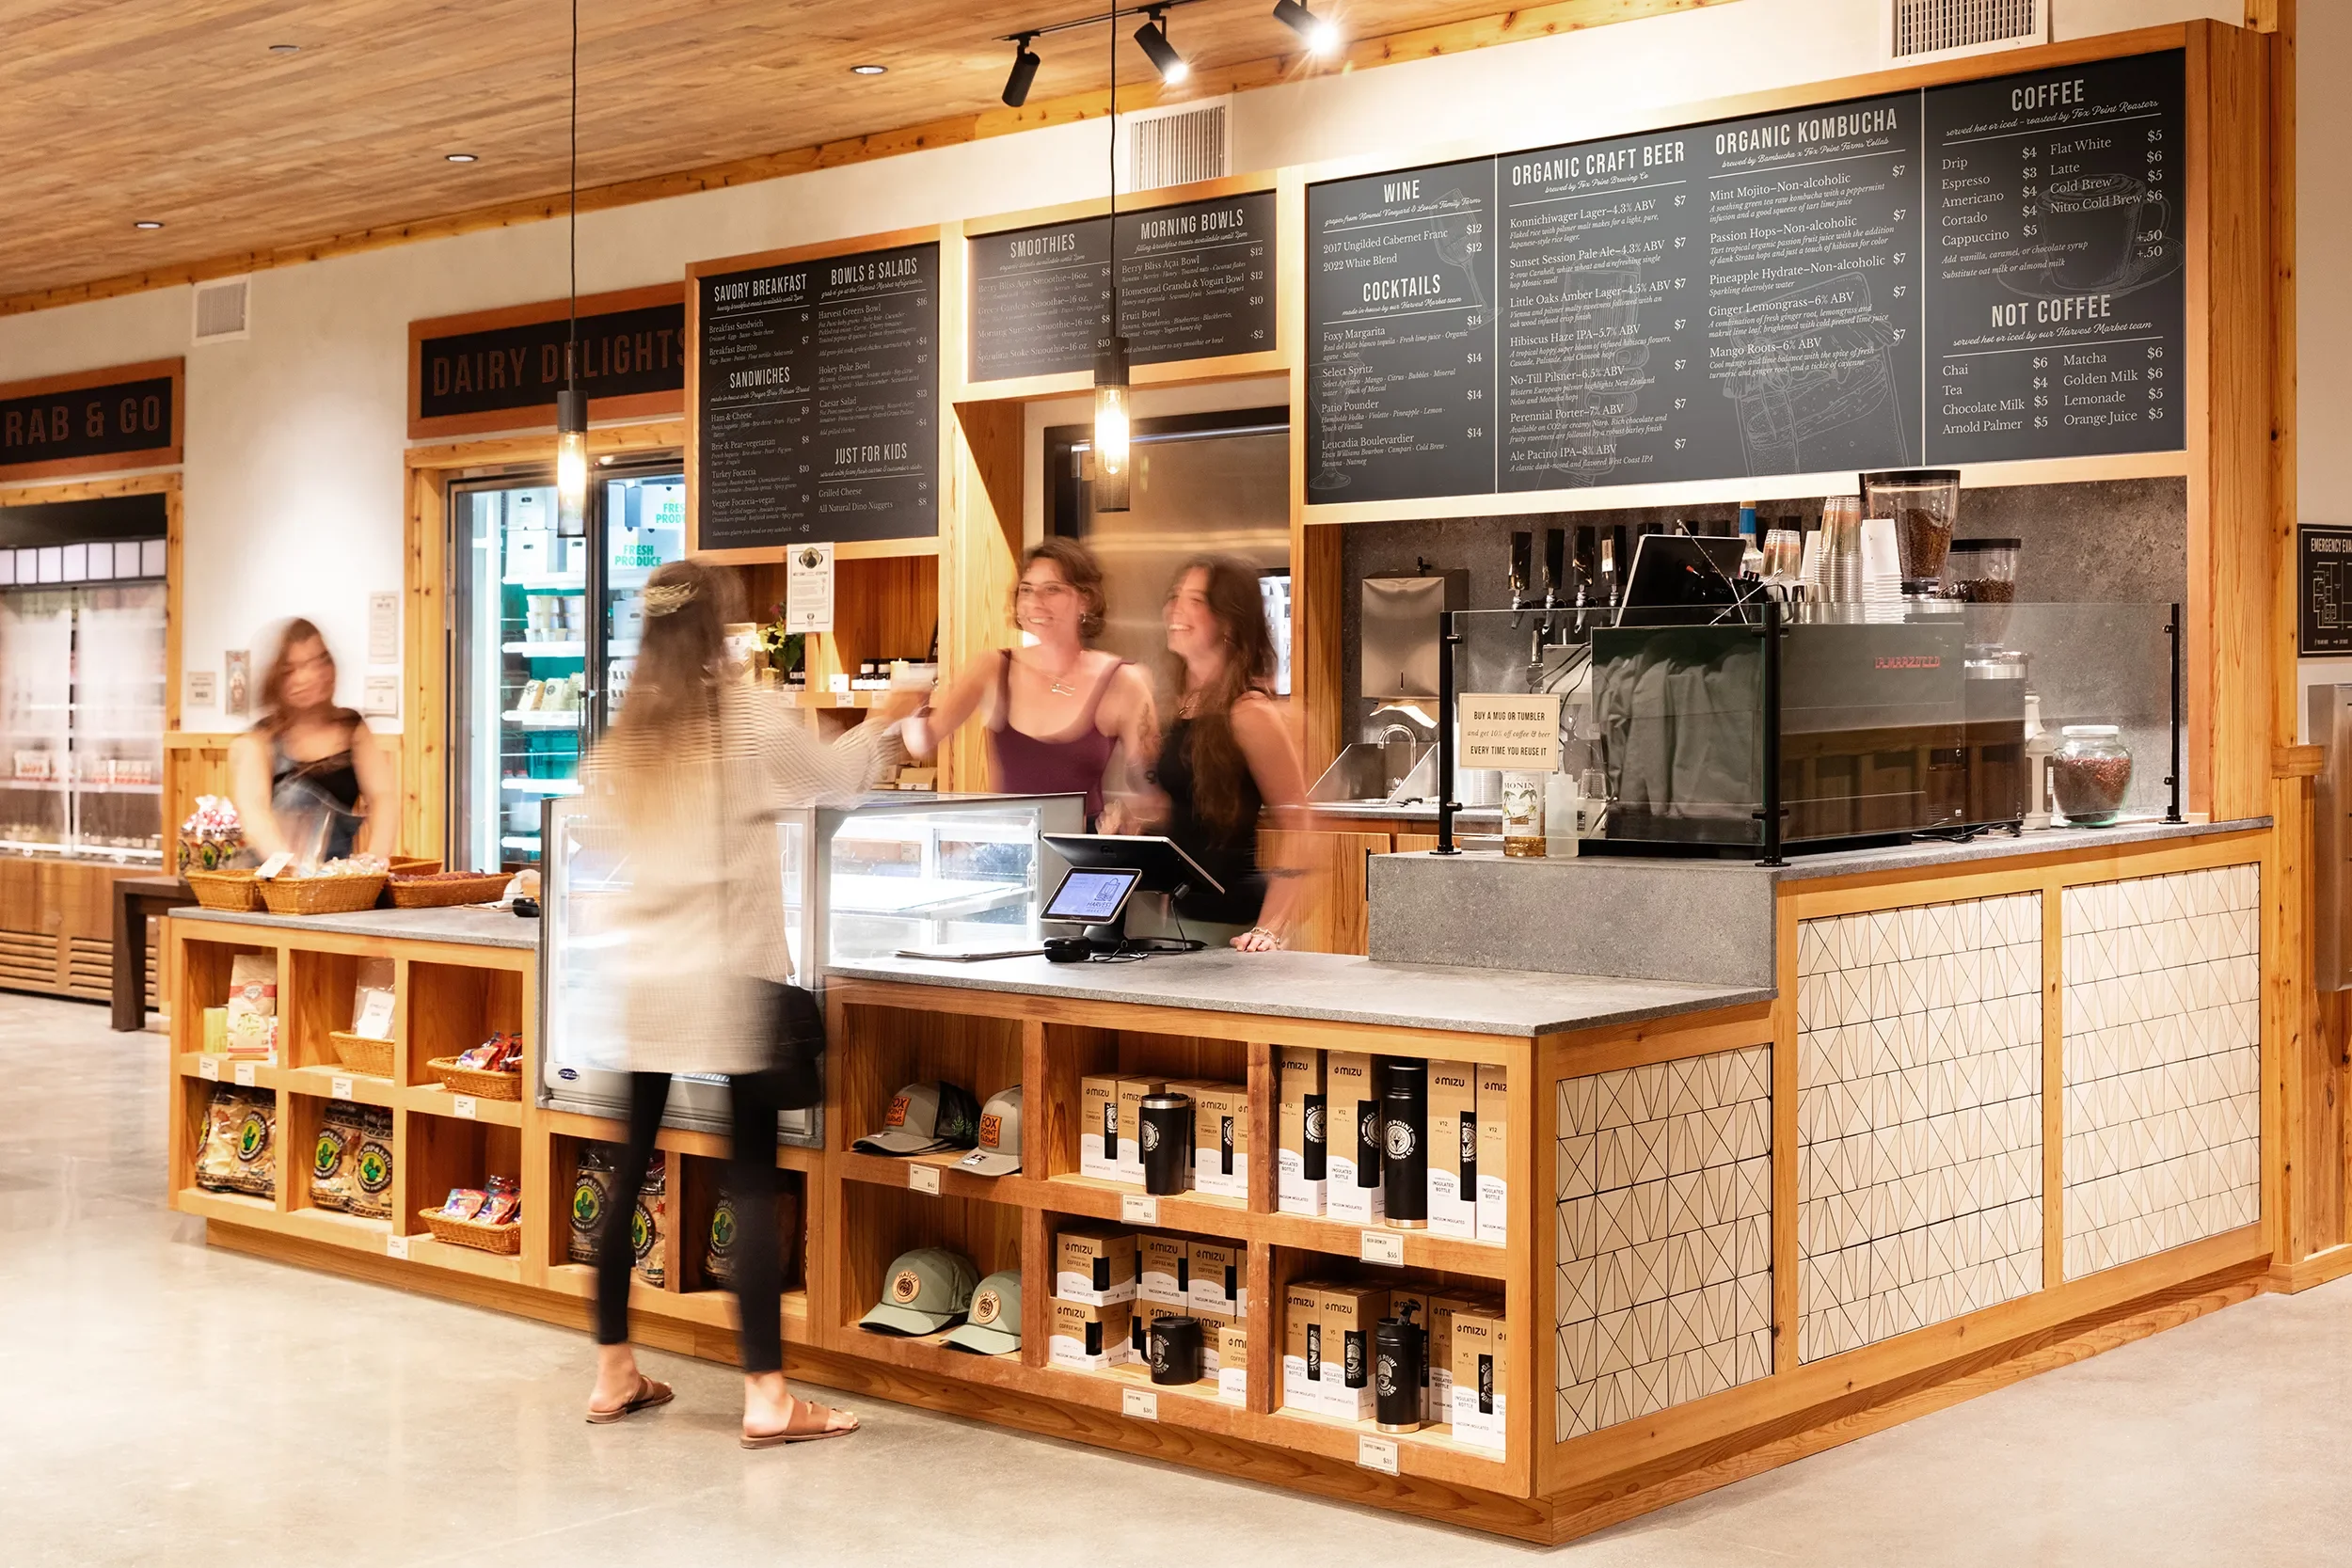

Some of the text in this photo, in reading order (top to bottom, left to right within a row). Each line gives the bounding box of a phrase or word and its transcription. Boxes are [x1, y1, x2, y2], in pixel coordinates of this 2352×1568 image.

[2012, 79, 2084, 111] COFFEE
[1716, 109, 1896, 155] ORGANIC KOMBUCHA
[2148, 130, 2162, 143] $5
[2051, 138, 2111, 155] Flat White
[2023, 147, 2037, 160] $4
[2147, 151, 2162, 163] $6
[1513, 142, 1683, 185] ORGANIC CRAFT BEER
[1942, 157, 1967, 170] Drip
[2051, 164, 2079, 175] Latte
[1893, 165, 1905, 177] $7
[2023, 167, 2036, 180] $3
[2148, 170, 2162, 182] $5
[1942, 177, 1990, 190] Espresso
[2050, 179, 2111, 193] Cold Brew
[1384, 180, 1419, 203] WINE
[1674, 195, 1686, 207] $7
[1716, 203, 1743, 212] soothing
[1744, 201, 1762, 209] green
[1790, 191, 1822, 201] kombucha
[1824, 189, 1839, 197] with
[1846, 184, 1884, 196] peppermint
[1511, 213, 1578, 228] Konnichiwager
[1634, 199, 1656, 211] ABV
[1141, 209, 1243, 239] MORNING BOWLS
[2023, 225, 2037, 237] $5
[1942, 230, 2009, 247] Cappuccino
[1011, 234, 1074, 258] SMOOTHIES
[1467, 243, 1482, 253] $12
[1942, 255, 1957, 264] Add
[2032, 243, 2066, 254] chocolate
[2067, 242, 2088, 251] syrup
[1324, 253, 1397, 271] 2022 White Blend
[832, 258, 917, 285] BOWLS & SALADS
[715, 274, 806, 302] SAVORY BREAKFAST
[1364, 274, 1440, 301] COCKTAILS
[1250, 296, 1263, 305] $10
[1142, 309, 1160, 318] Bowl
[1992, 294, 2110, 327] NOT COFFEE
[709, 320, 763, 333] Breakfast Sandwich
[1467, 315, 1482, 326] $14
[1324, 327, 1385, 342] Foxy Margarita
[2064, 353, 2106, 365] Matcha
[2148, 347, 2162, 360] $6
[2033, 357, 2047, 369] $6
[433, 347, 527, 396] DAIRY
[1943, 364, 1968, 376] Chai
[730, 367, 789, 388] SANDWICHES
[2034, 377, 2048, 389] $4
[1943, 385, 1962, 395] Tea
[86, 402, 104, 437] &
[120, 396, 160, 434] GO
[835, 443, 906, 464] JUST FOR KIDS
[819, 488, 839, 497] Grilled
[663, 503, 685, 513] FRES
[624, 545, 654, 557] FRESH
[2311, 538, 2352, 553] EMERGENCY EVA
[614, 555, 662, 567] PRODUCE
[1518, 712, 1545, 721] TUMBLER
[1504, 730, 1512, 738] off
[1513, 730, 1529, 738] coffee
[1471, 746, 1489, 754] EVERY
[1492, 746, 1505, 755] TIME
[1508, 747, 1518, 755] YOU
[1521, 747, 1539, 755] REUSE
[1287, 1062, 1308, 1070] MIZU
[1340, 1067, 1362, 1076] MIZU
[1441, 1077, 1465, 1087] MIZU
[1491, 1082, 1507, 1092] MIZ
[1091, 1089, 1109, 1097] MIZU
[982, 1116, 998, 1129] FOX
[1393, 1120, 1413, 1132] POINT
[981, 1127, 997, 1136] POINT
[1071, 1243, 1093, 1255] MIZU
[1155, 1243, 1178, 1254] MIZU
[1201, 1250, 1225, 1262] MIZU
[898, 1273, 917, 1283] HATCH
[980, 1292, 997, 1302] HATCH
[1293, 1297, 1314, 1308] MIZU
[1063, 1307, 1085, 1318] MIZU
[1331, 1303, 1352, 1314] MIZU
[1463, 1326, 1486, 1336] MIZU
